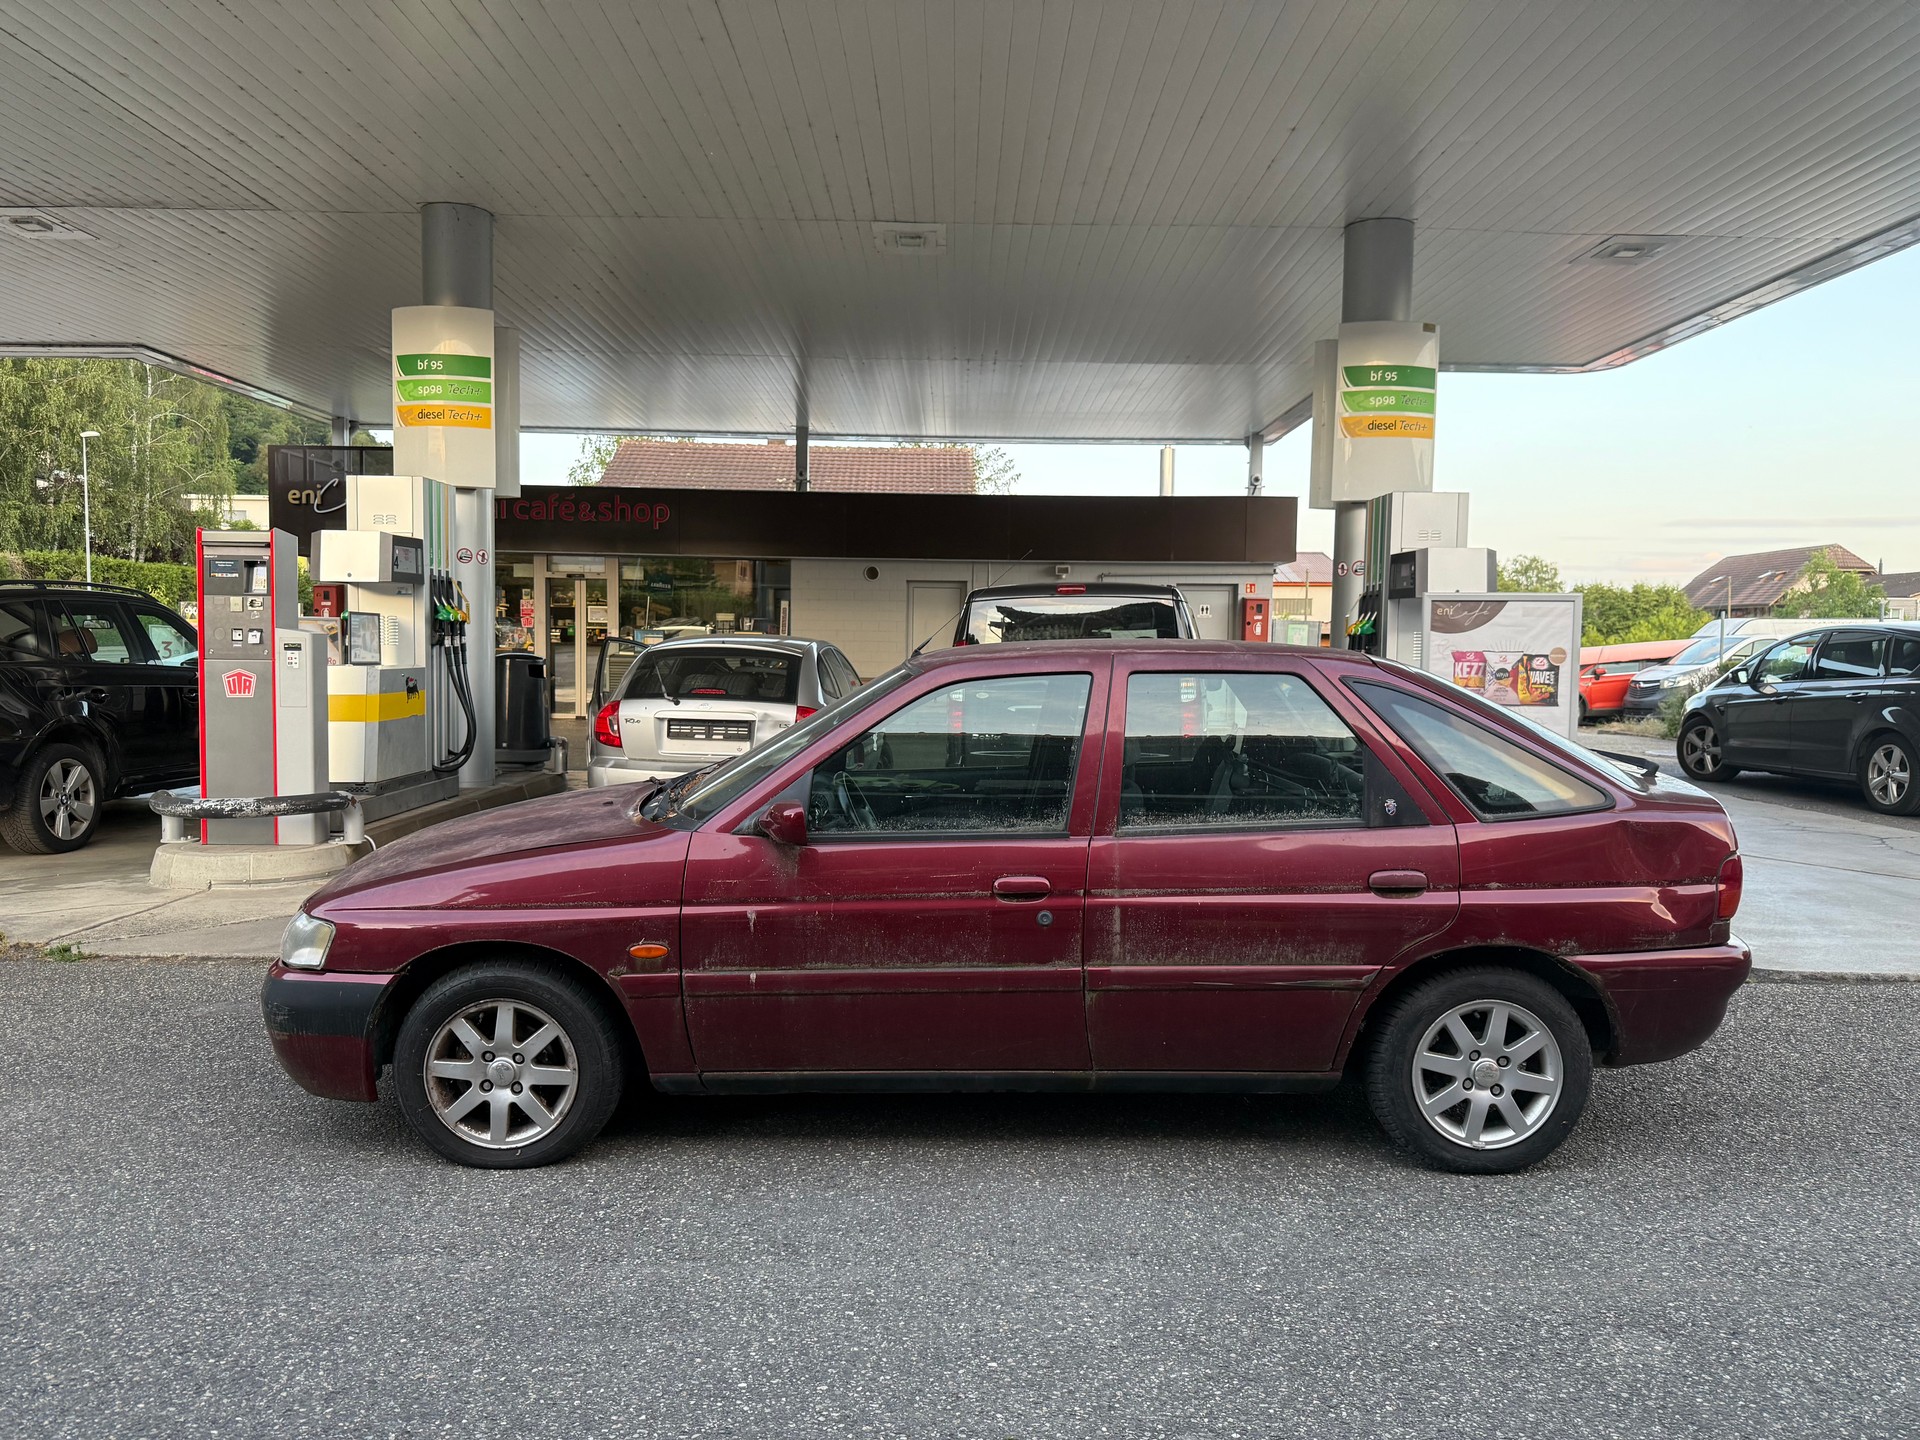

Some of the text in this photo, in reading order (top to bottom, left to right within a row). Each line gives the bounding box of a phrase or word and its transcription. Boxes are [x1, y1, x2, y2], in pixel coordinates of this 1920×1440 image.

[417, 359, 443, 370] bf 95
[1370, 370, 1398, 381] bf 95
[417, 383, 483, 398] sp98 Tech+
[1369, 394, 1428, 407] sp98 Tech+
[417, 408, 483, 421] diesel Tech+
[1367, 420, 1428, 431] diesel Tech+
[1454, 661, 1486, 678] KEZZ
[226, 671, 253, 695] UTA
